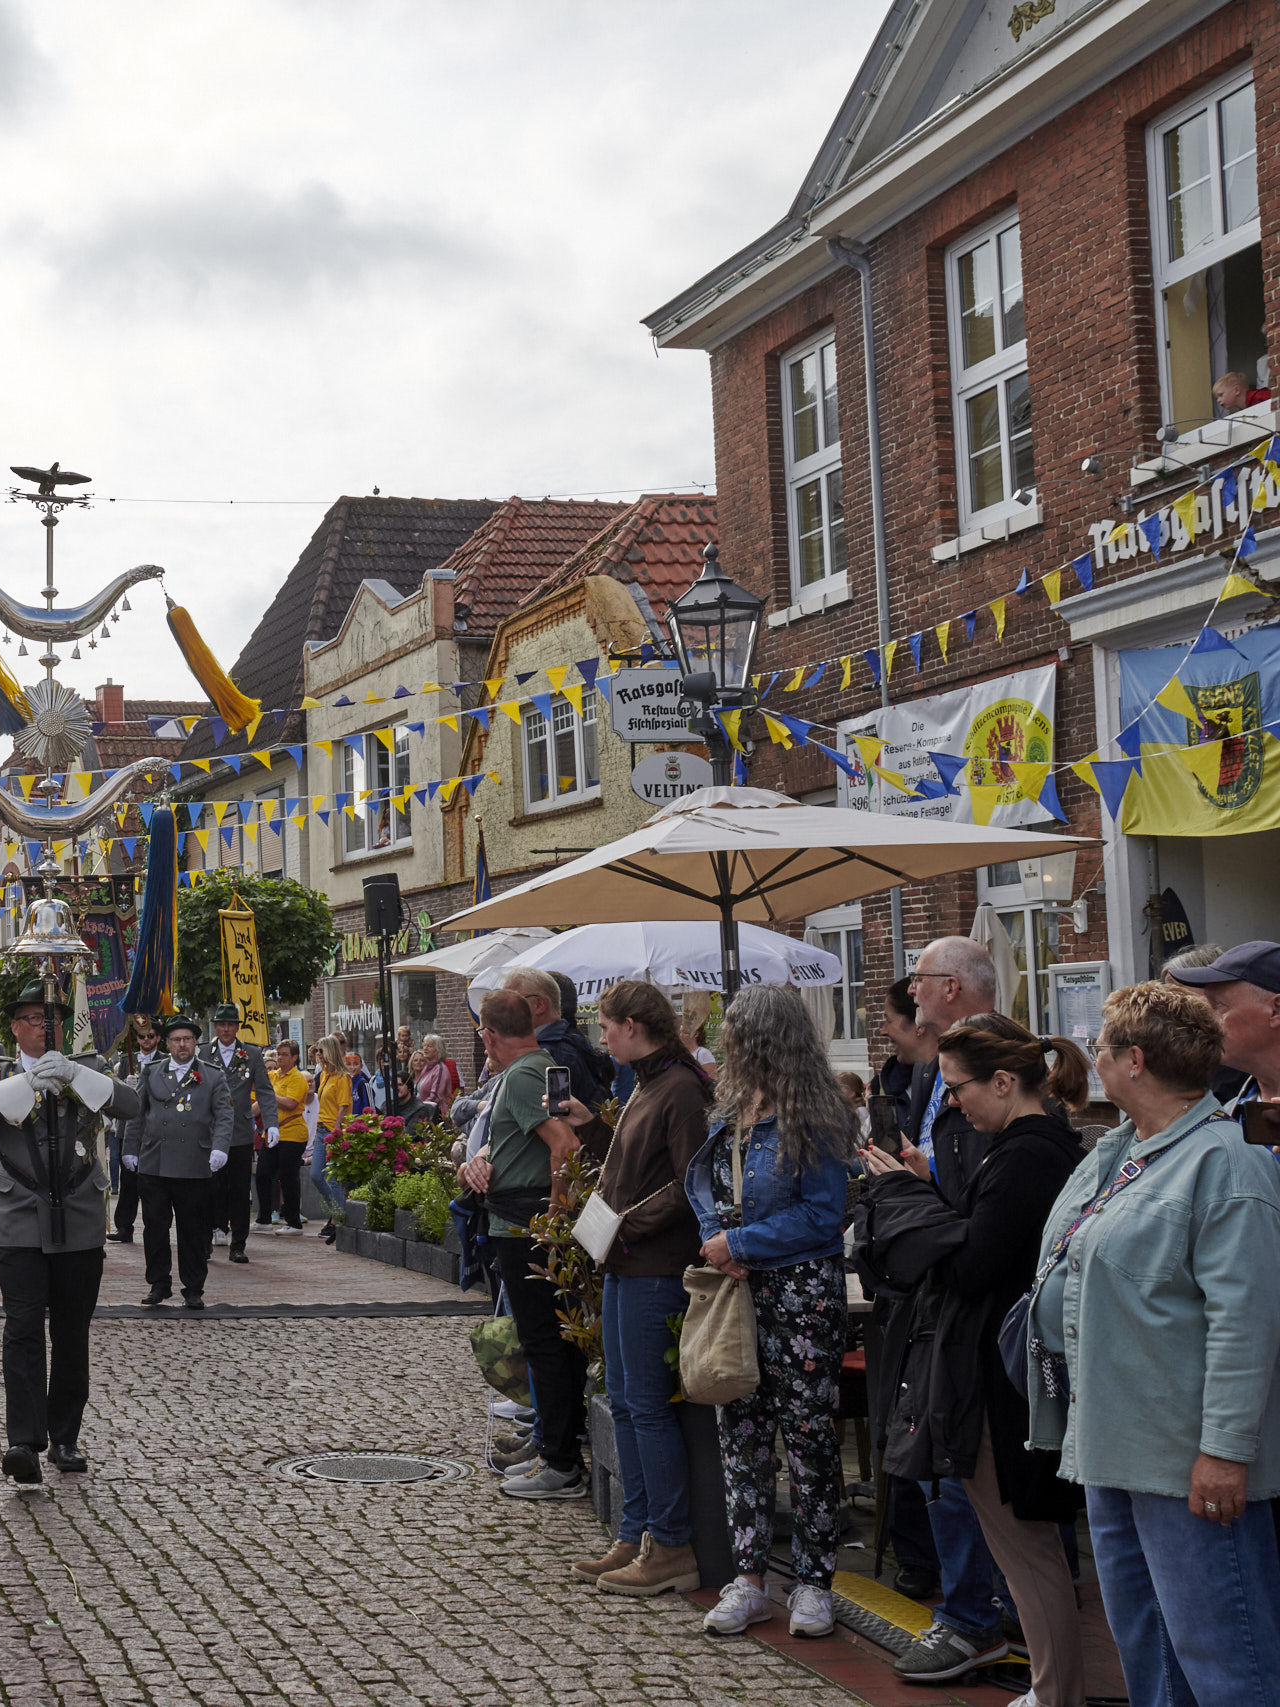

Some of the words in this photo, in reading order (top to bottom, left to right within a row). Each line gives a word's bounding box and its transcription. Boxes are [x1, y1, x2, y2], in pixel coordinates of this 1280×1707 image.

[1198, 684, 1245, 708] ESENS
[911, 721, 925, 732] Die
[898, 759, 911, 770] aus
[87, 977, 127, 999] pagnie
